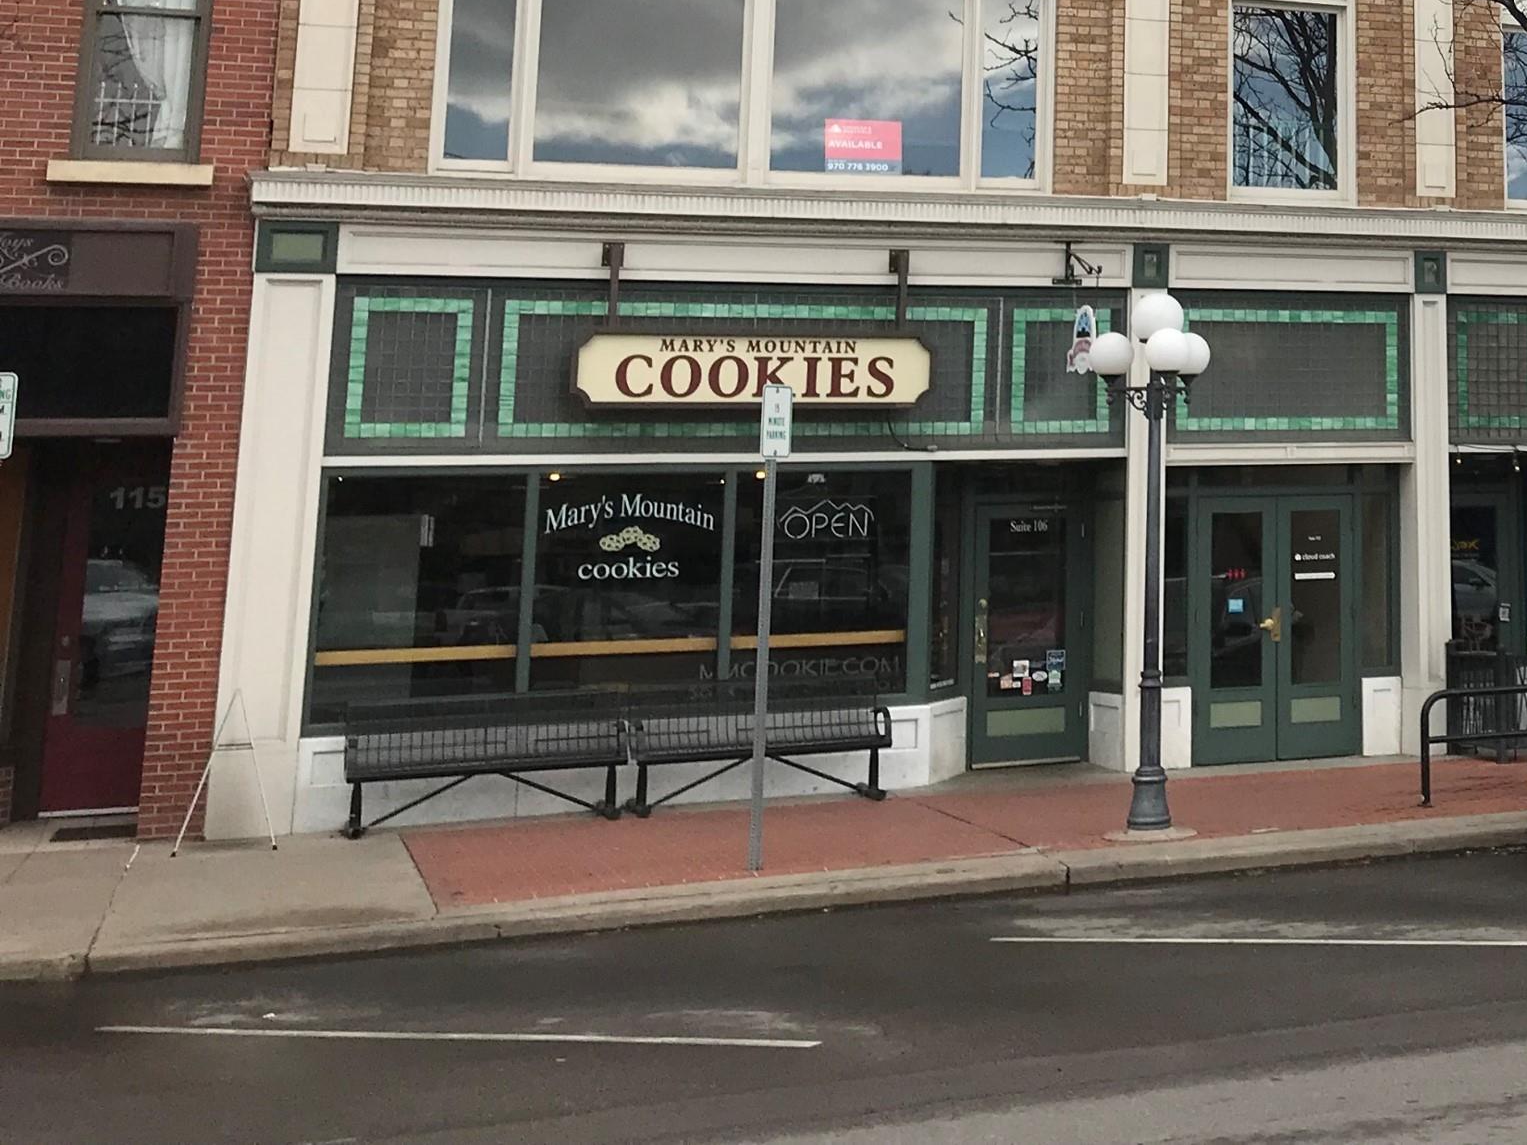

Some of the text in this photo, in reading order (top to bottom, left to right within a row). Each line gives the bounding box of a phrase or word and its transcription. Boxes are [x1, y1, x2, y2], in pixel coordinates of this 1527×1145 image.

[828, 140, 883, 150] AVAILABLE
[659, 338, 858, 354] MARY'S MOUNTAIN
[615, 354, 896, 399] COOKIES
[109, 486, 166, 509] 115
[544, 493, 715, 534] Mary's Mountain
[784, 512, 868, 540] OPEN
[577, 556, 680, 580] cookies
